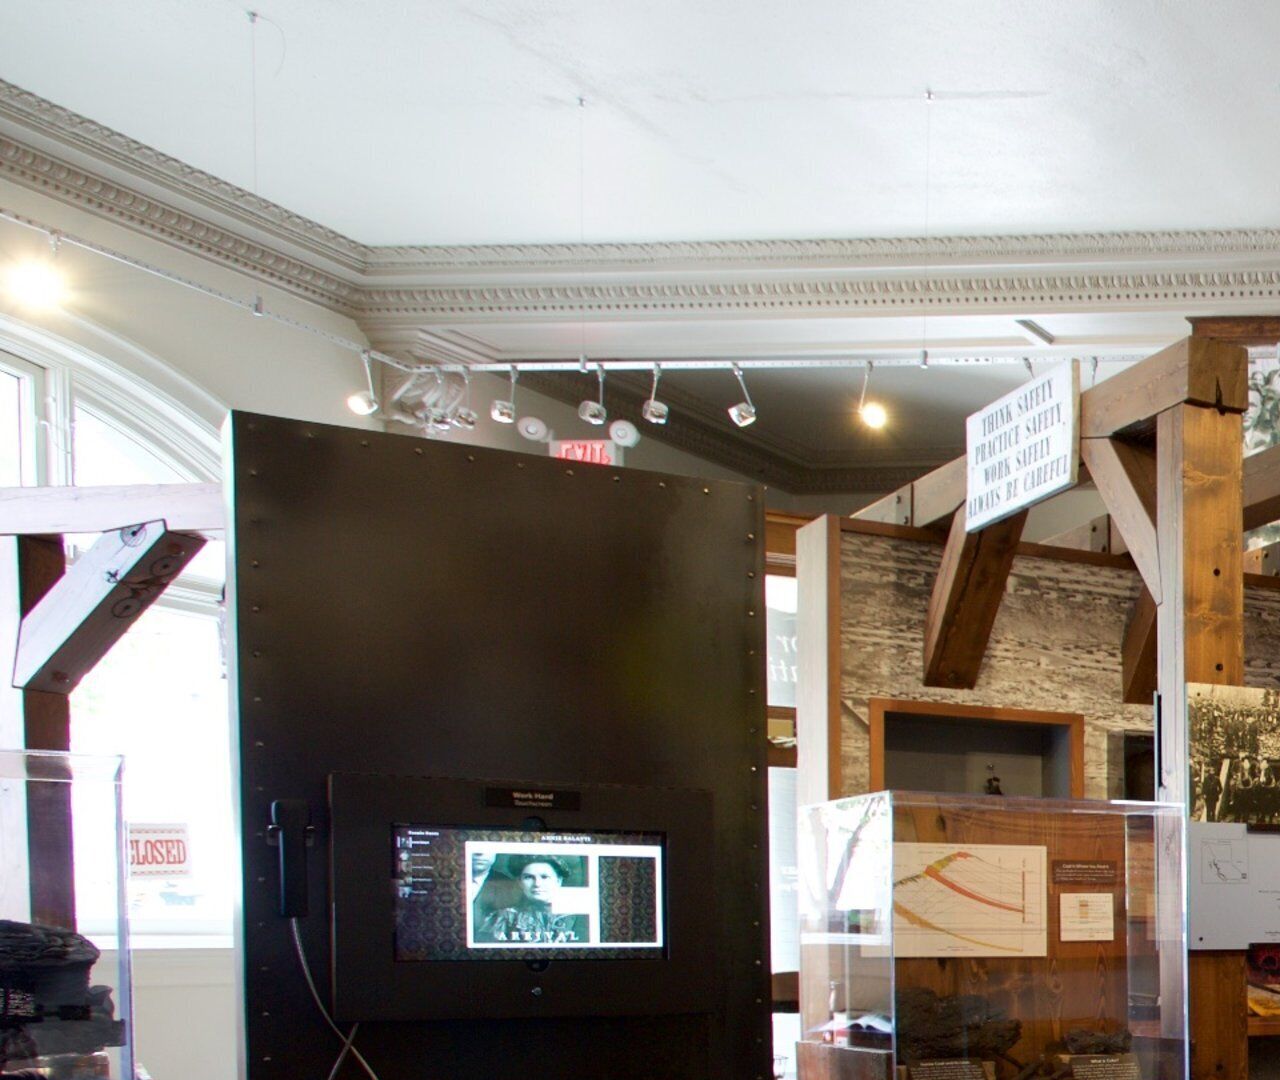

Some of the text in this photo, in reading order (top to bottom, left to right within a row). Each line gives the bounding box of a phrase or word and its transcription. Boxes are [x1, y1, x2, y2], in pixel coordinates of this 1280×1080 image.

[982, 377, 1054, 438] THINK SAFETY
[974, 424, 1021, 467] PRACTICE
[968, 453, 1069, 520] ALWAYS BE CAREFUL
[983, 458, 1011, 487] WORK
[129, 839, 187, 865] CLOSED
[498, 930, 579, 943] ARRIVAL
